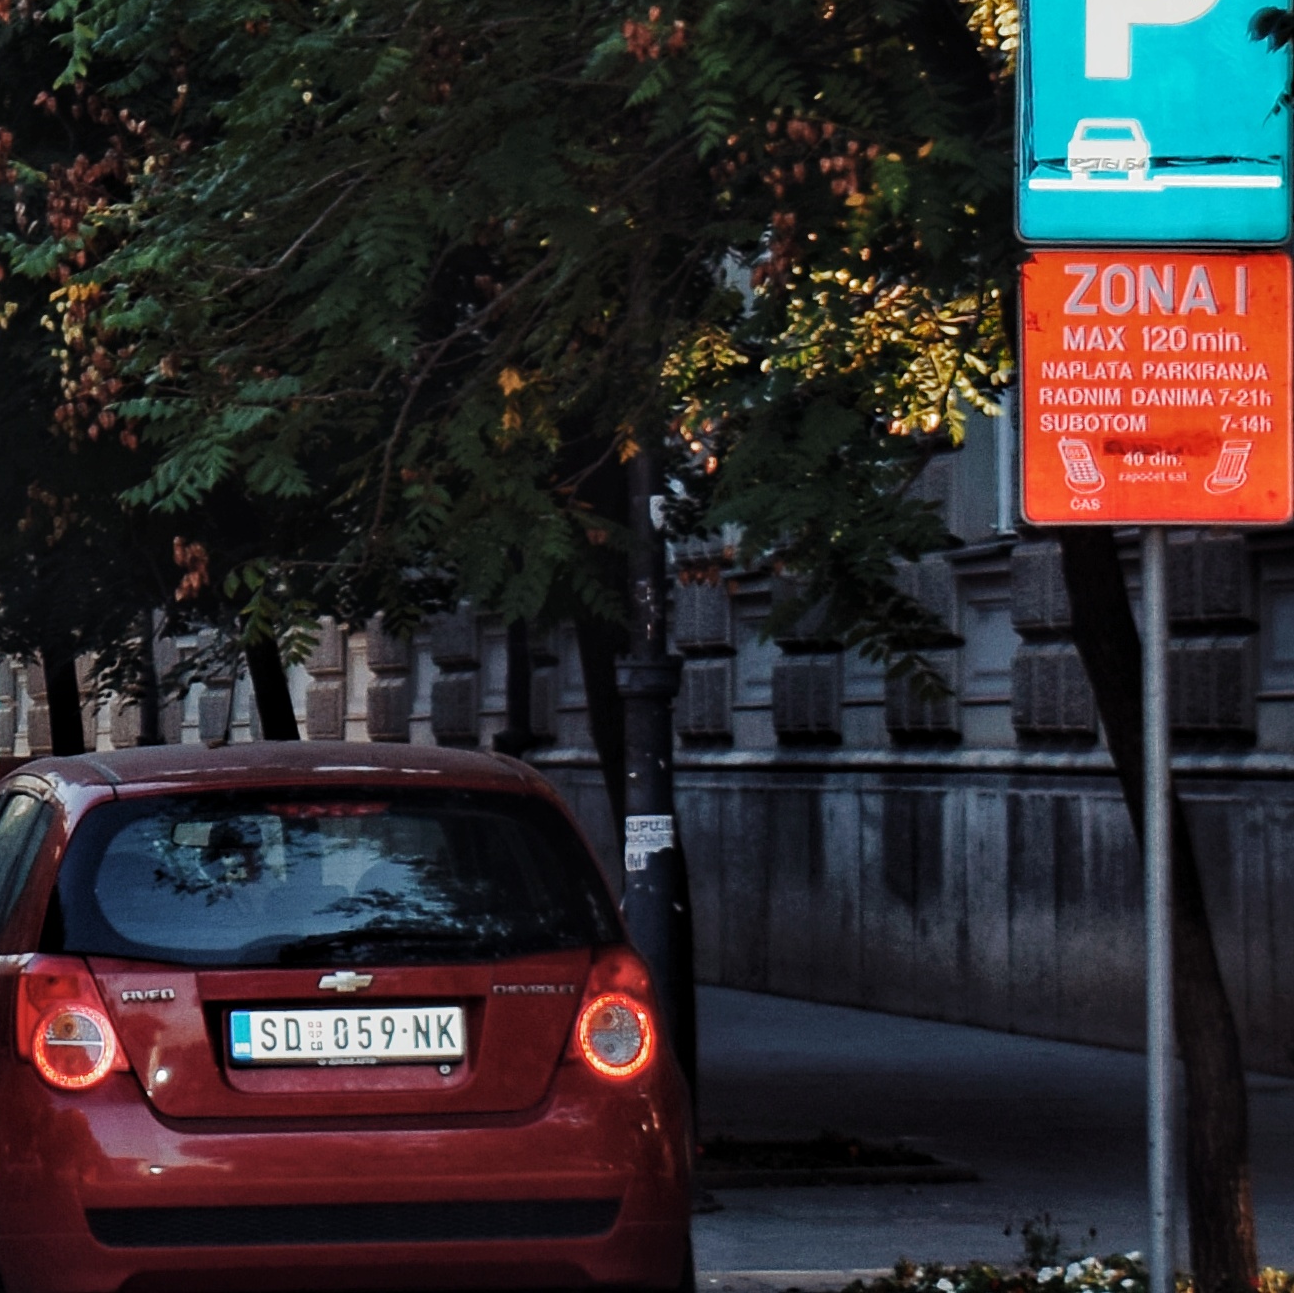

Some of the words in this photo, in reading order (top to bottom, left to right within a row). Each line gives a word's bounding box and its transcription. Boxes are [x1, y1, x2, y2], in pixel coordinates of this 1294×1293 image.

[1064, 265, 1219, 315] ZONA
[1235, 266, 1248, 315] I
[1063, 325, 1126, 351] MAX
[1142, 325, 1187, 352] 120
[1192, 327, 1249, 352] min.
[1042, 362, 1133, 380] NAPLATA
[1142, 362, 1268, 381] PARKIRANJA
[1039, 388, 1122, 406] RADNIM
[1131, 388, 1214, 406] DANIMA
[1218, 388, 1272, 407] 7-21h
[1040, 414, 1147, 432] SUBOTOM
[1220, 414, 1272, 432] 7-14h
[1123, 451, 1145, 466] 40
[1070, 496, 1102, 511] ČAS
[260, 1017, 302, 1052] SD
